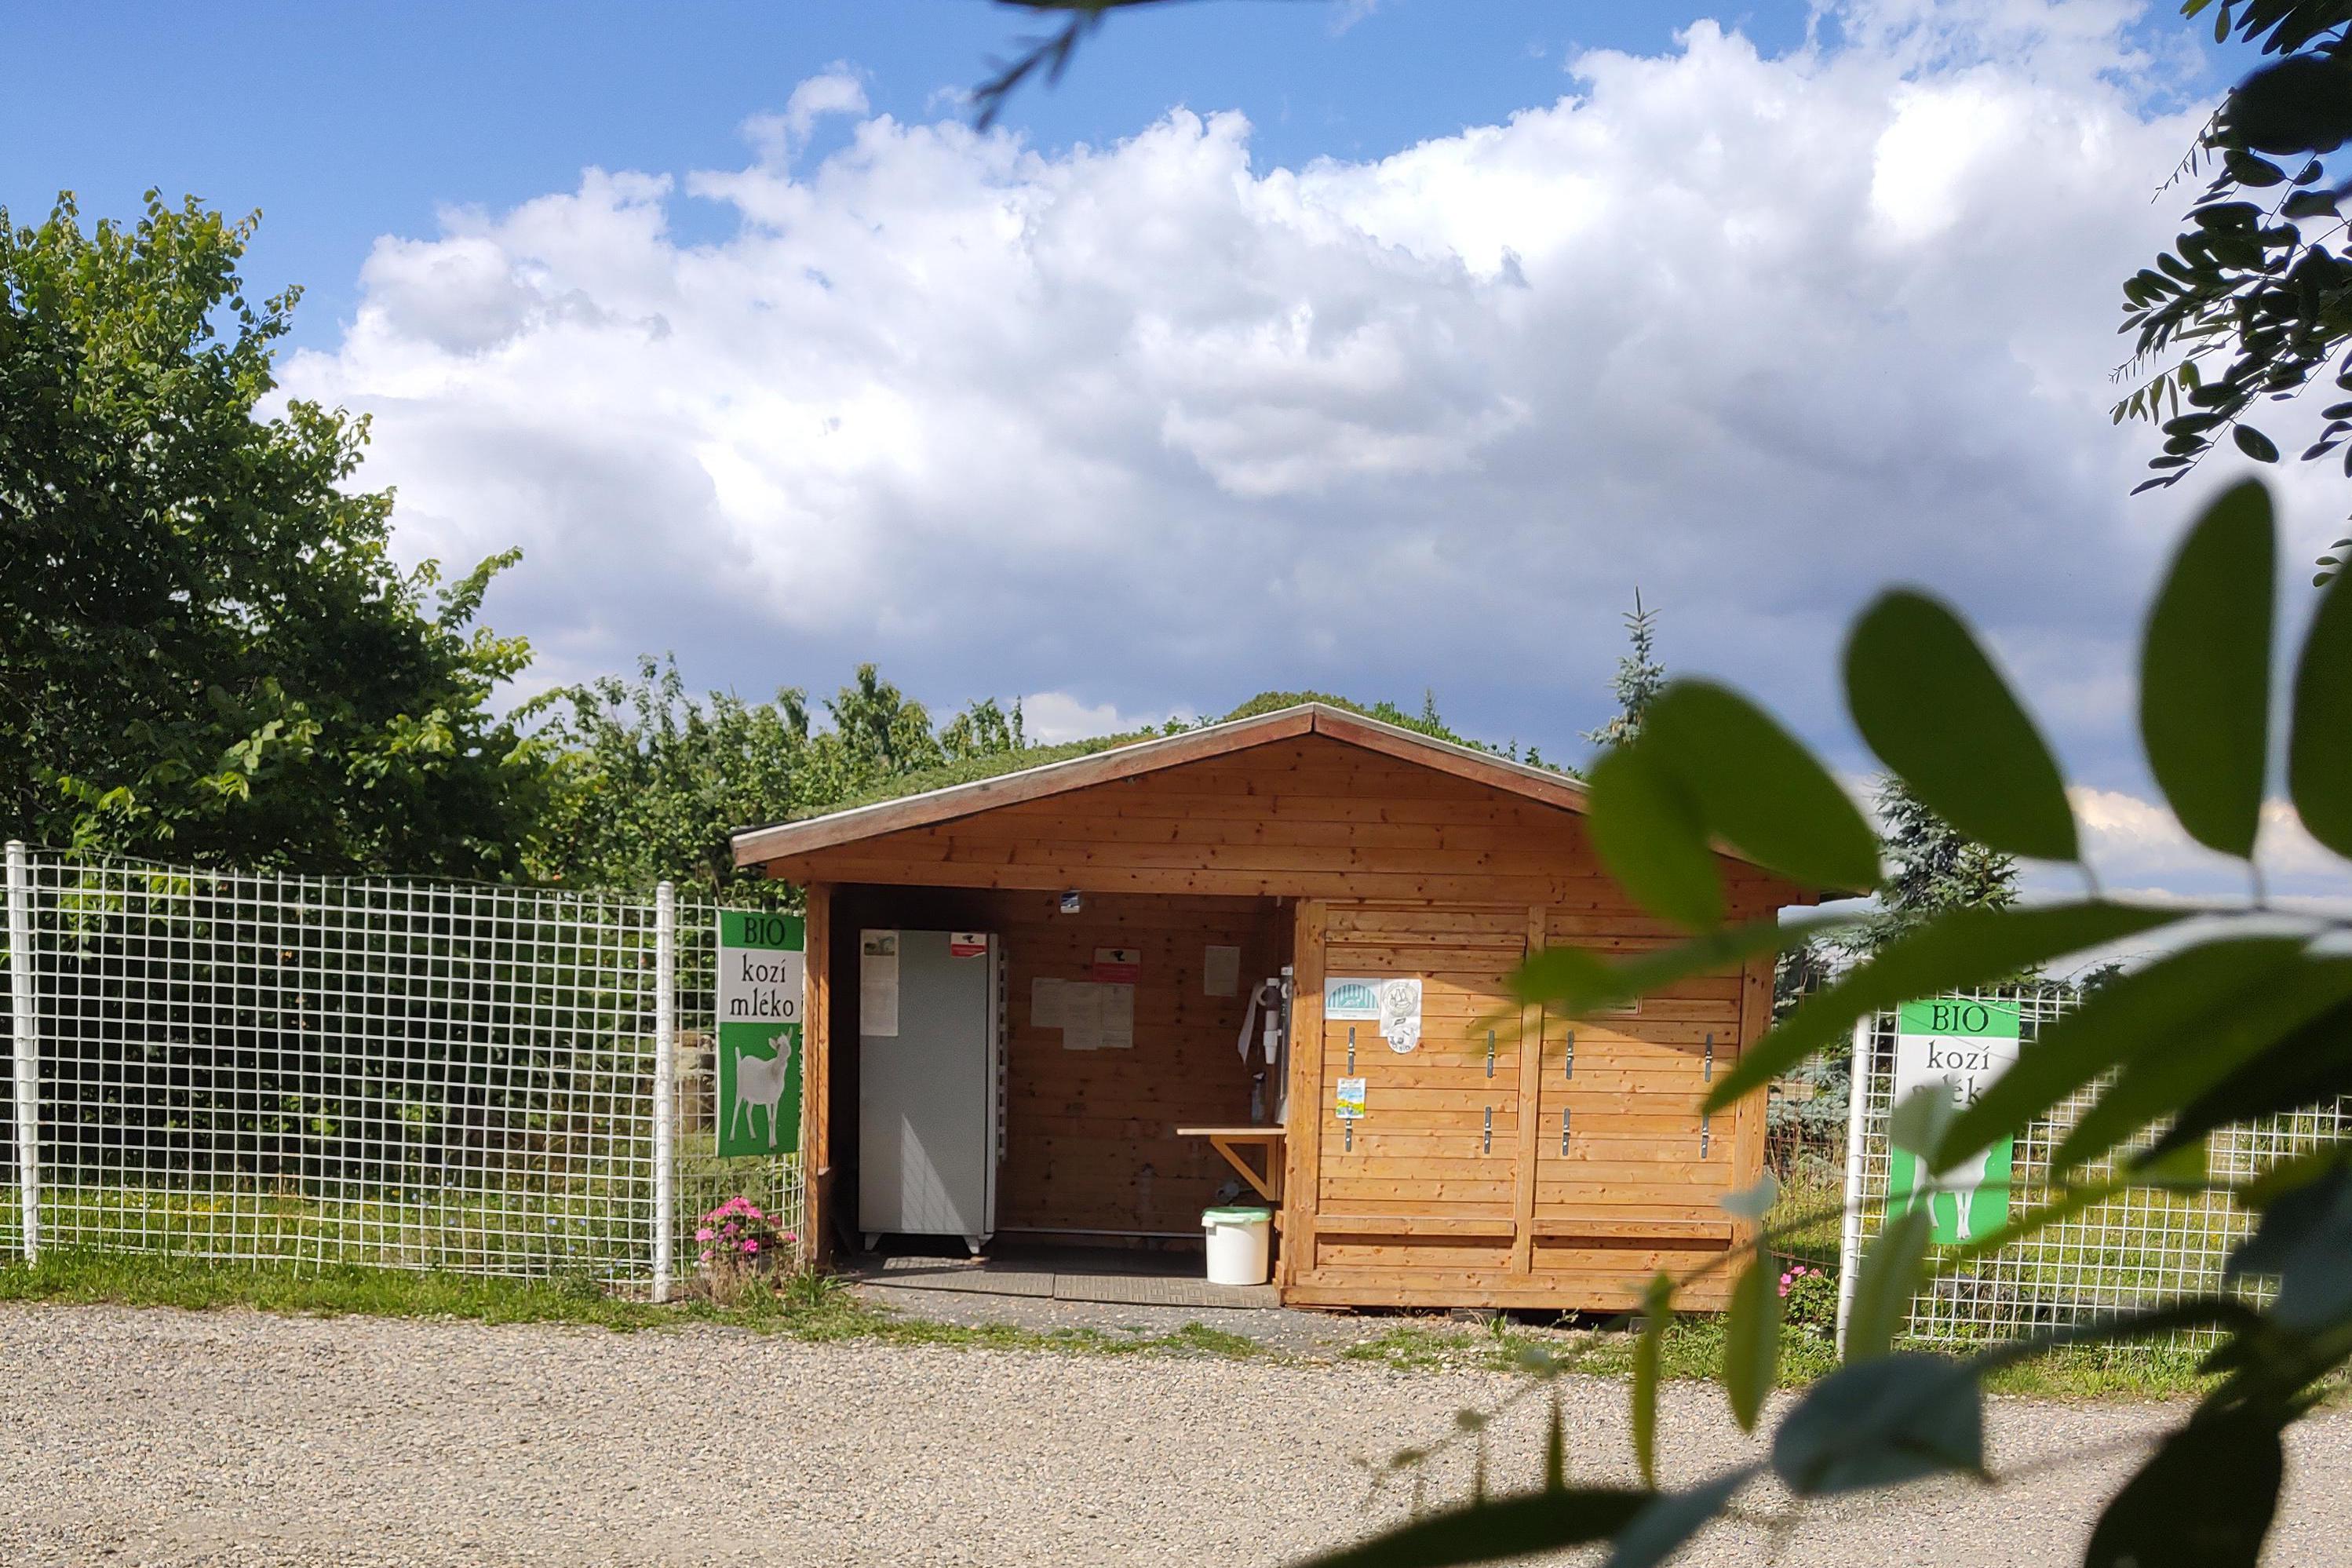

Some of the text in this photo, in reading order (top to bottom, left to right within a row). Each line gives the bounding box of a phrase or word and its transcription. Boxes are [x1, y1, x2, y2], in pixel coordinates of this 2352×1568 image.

[744, 917, 785, 946] BIO
[742, 953, 786, 983] kozí
[729, 987, 793, 1016] mléko
[1931, 1004, 1989, 1032] BIO
[1927, 1040, 1989, 1070] kozí
